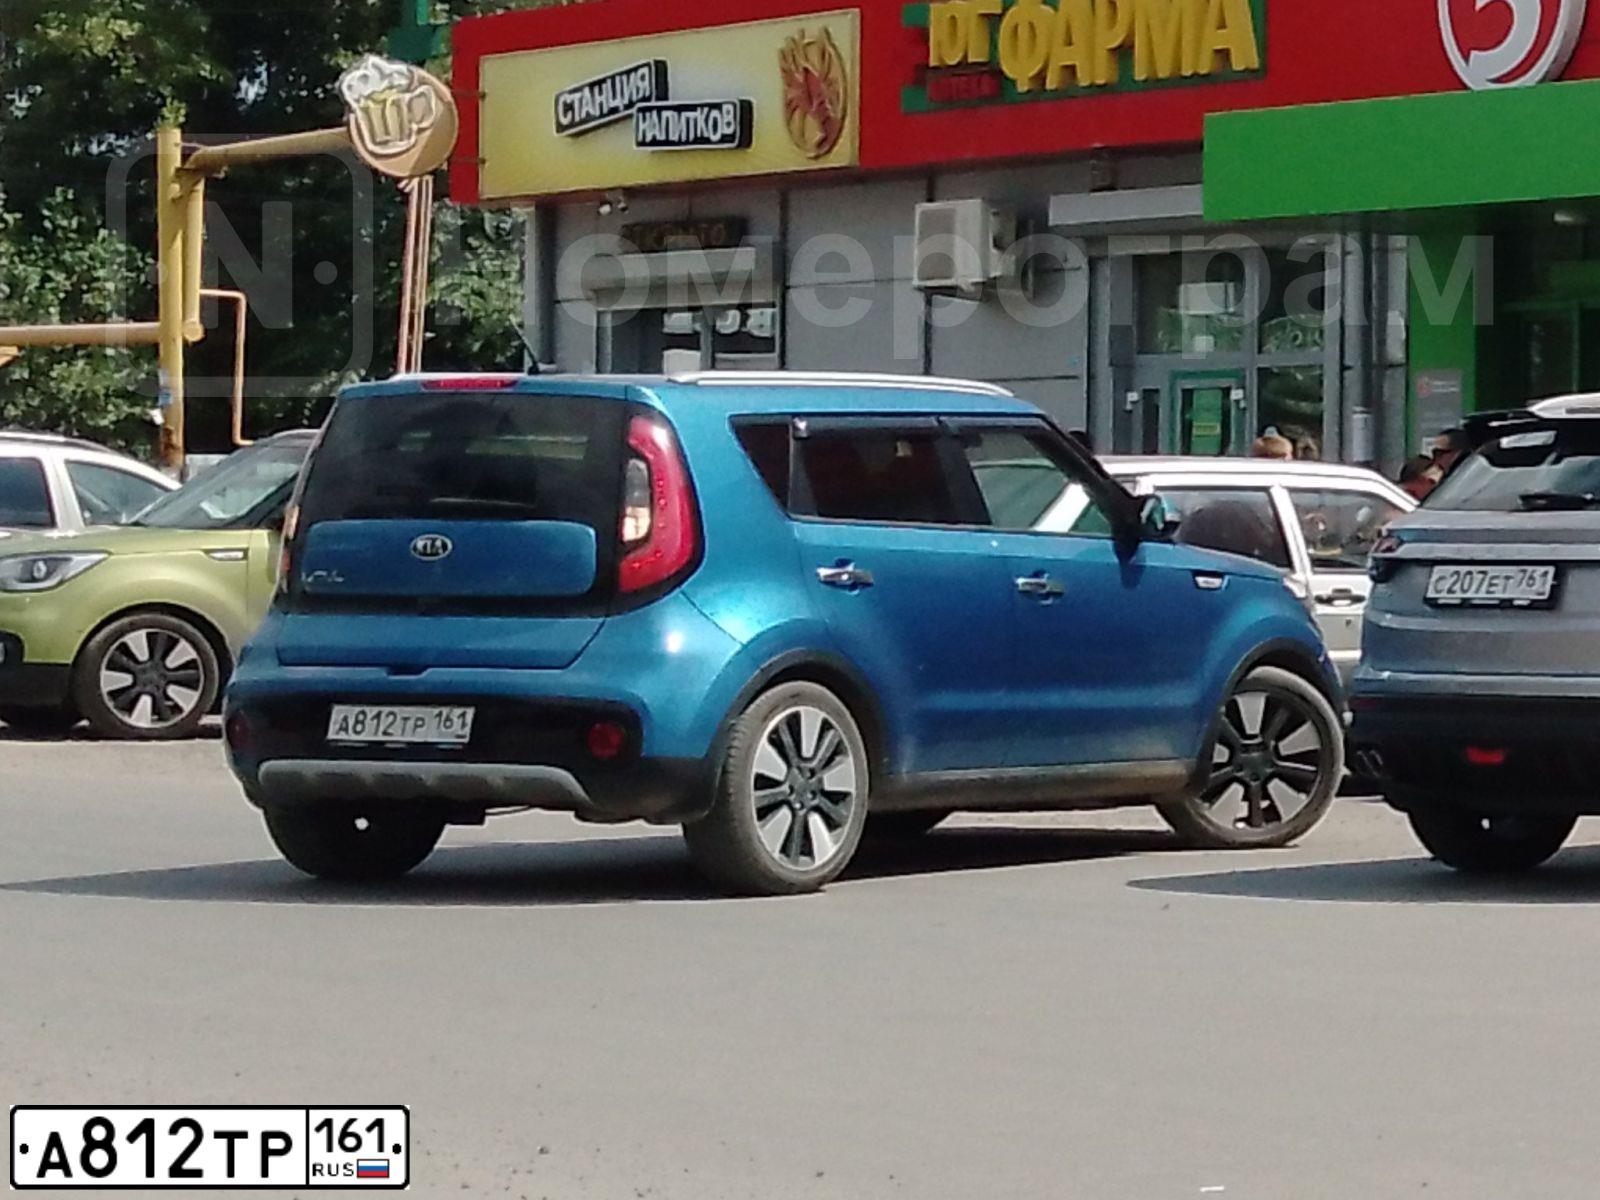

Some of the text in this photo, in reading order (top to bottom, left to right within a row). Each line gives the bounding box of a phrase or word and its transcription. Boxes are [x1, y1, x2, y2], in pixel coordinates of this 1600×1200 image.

[929, 0, 1260, 93] ЮГ ФАРМА
[557, 66, 650, 125] СТАНЦИЯ
[637, 103, 736, 143] НАПИТКОВ
[1433, 569, 1549, 595] С207ЕТ 761
[335, 709, 468, 736] А812ТР 161
